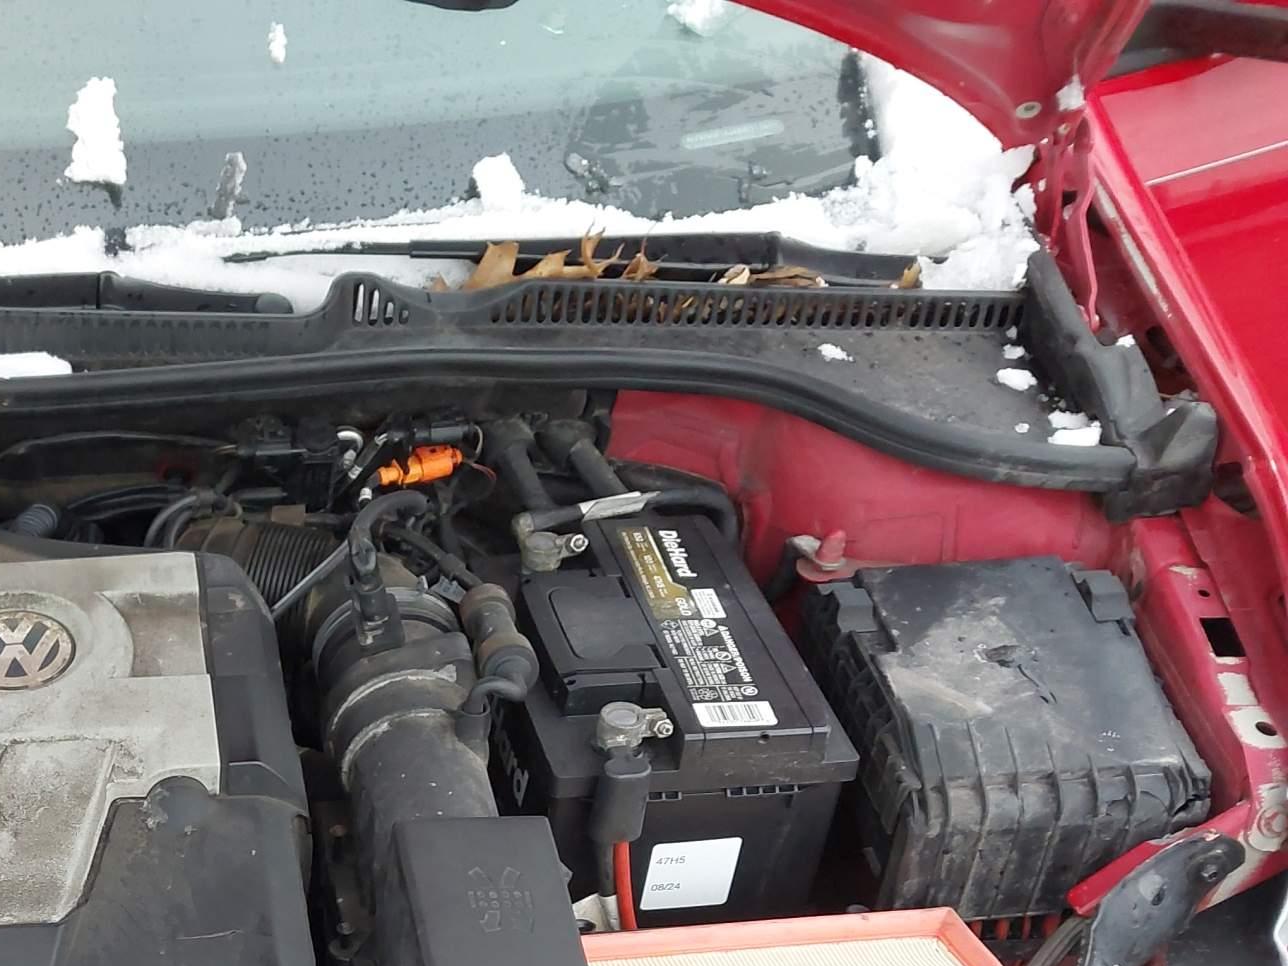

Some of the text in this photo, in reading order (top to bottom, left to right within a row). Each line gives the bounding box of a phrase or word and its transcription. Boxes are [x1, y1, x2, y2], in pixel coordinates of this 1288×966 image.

[658, 530, 698, 577] DieHard
[675, 597, 692, 616] GOLD
[655, 855, 686, 865] 47H5
[650, 882, 681, 892] 08/24
